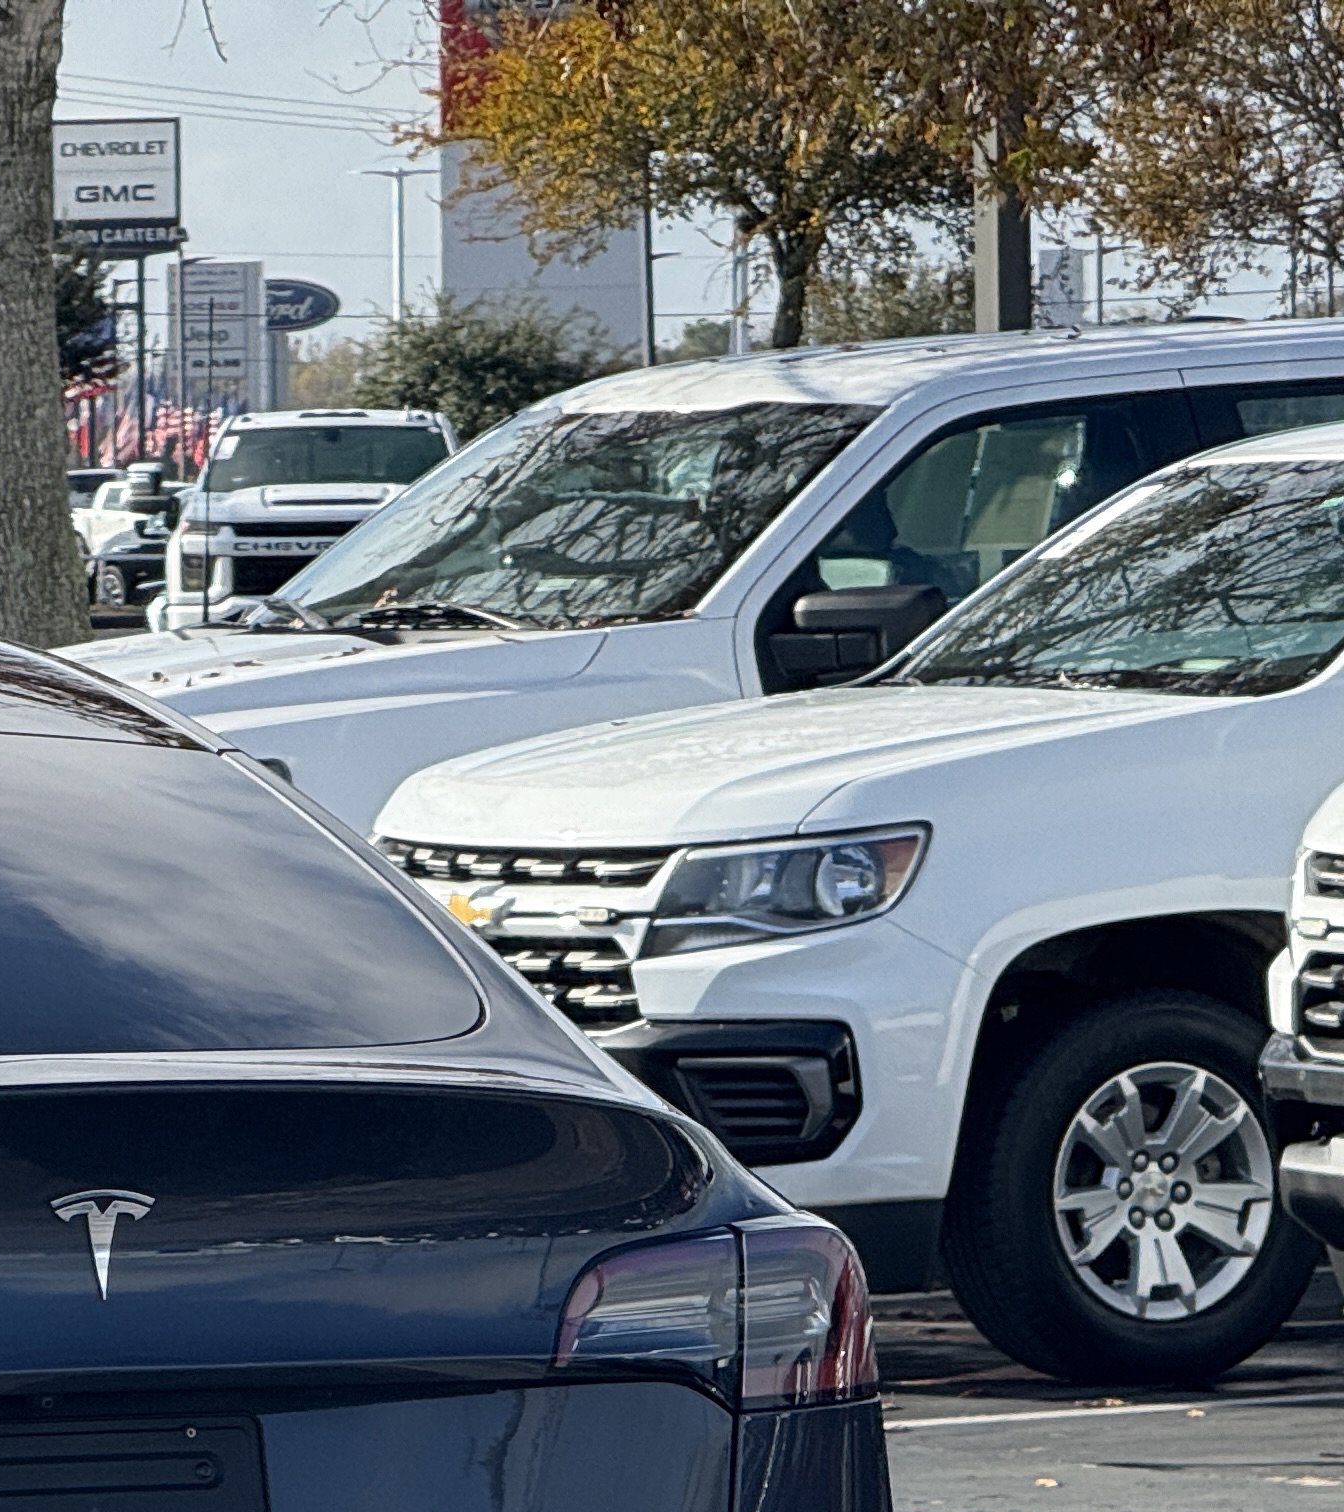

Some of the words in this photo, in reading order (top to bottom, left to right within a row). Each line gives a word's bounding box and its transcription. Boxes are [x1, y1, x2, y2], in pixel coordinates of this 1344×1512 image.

[60, 140, 168, 157] CHEVROLET
[75, 184, 155, 203] GMC
[266, 296, 313, 321] ord
